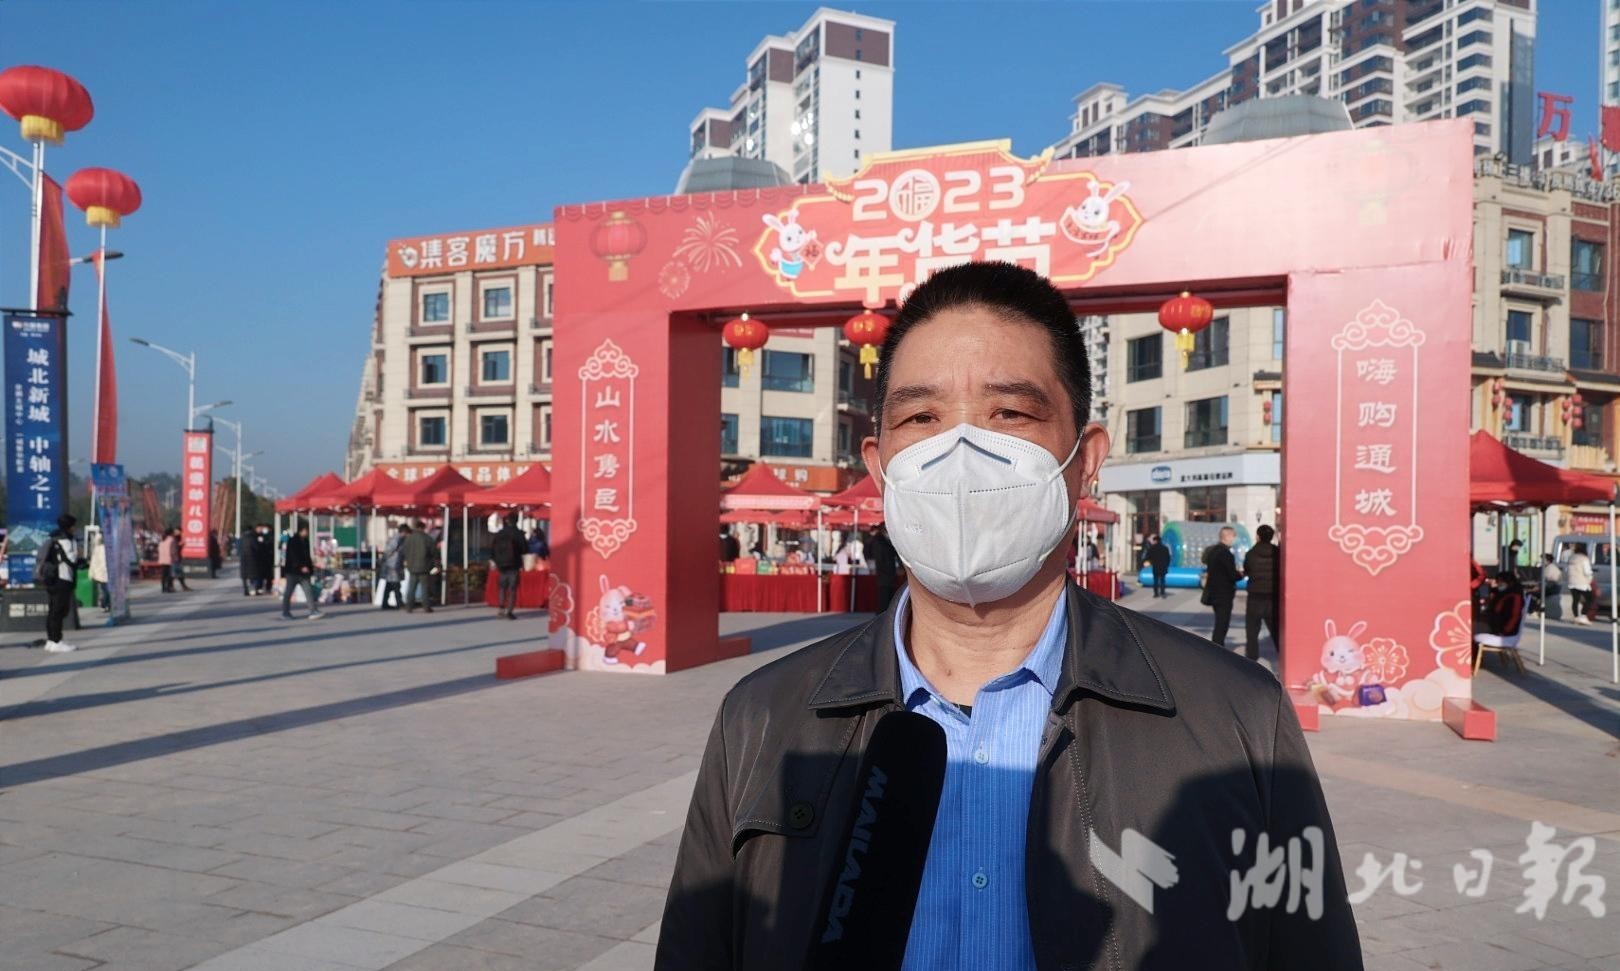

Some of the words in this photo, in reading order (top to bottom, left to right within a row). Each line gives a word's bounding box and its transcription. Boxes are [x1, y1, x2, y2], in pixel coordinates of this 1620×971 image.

[1537, 91, 1574, 142] 万
[418, 230, 526, 269] 集客魔方
[826, 215, 1057, 305] 年货节
[26, 347, 51, 424] 城北新城
[29, 435, 52, 511] 中轴之上
[592, 384, 622, 513] 山水隽邑
[1354, 357, 1398, 517] 嗨购通城
